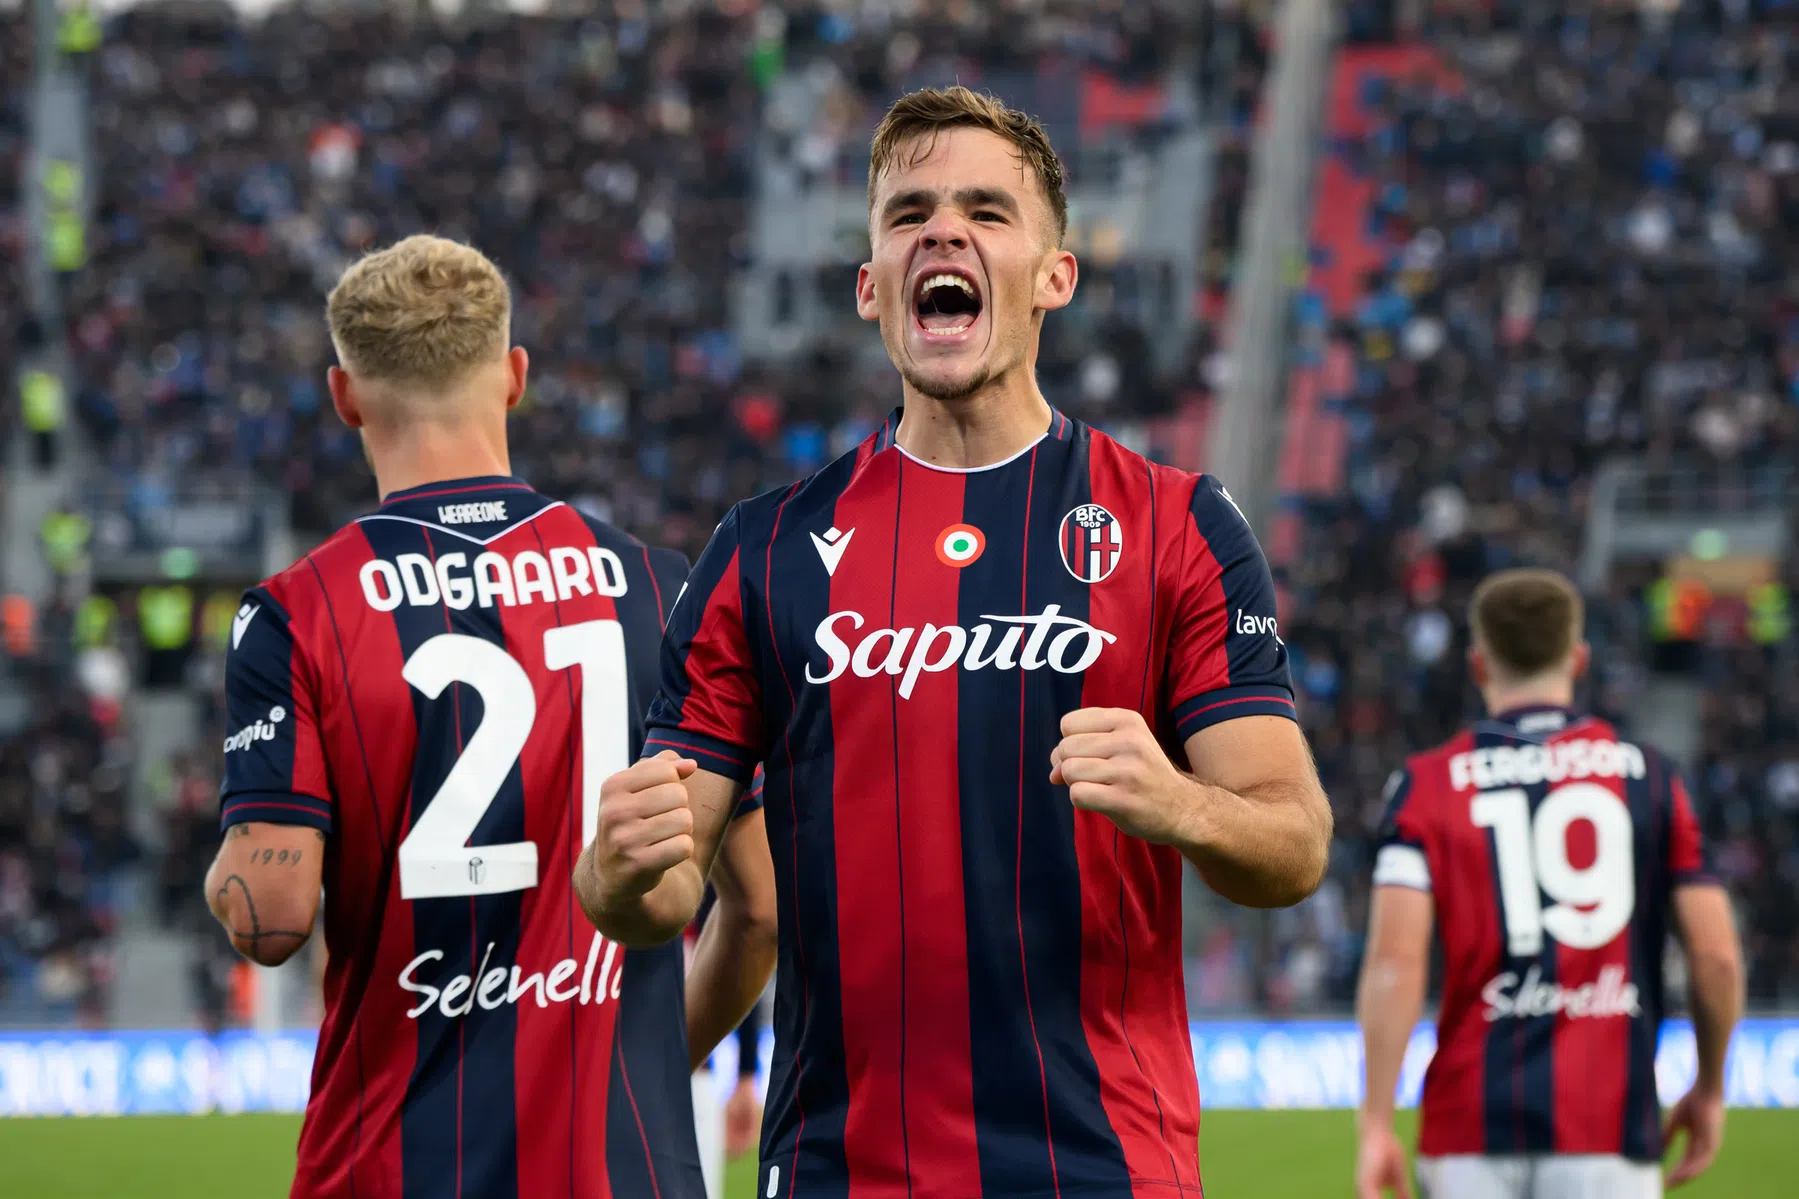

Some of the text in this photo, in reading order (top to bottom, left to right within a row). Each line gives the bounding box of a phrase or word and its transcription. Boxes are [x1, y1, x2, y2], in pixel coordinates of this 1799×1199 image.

[437, 500, 508, 524] WEAREONE
[1075, 506, 1106, 522] BFC
[359, 546, 628, 612] ODGAARD
[805, 604, 1118, 700] Saputo
[400, 619, 629, 900] 21
[1449, 738, 1647, 792] FERGUSON
[250, 848, 303, 867] 1999
[1469, 782, 1636, 957] 19
